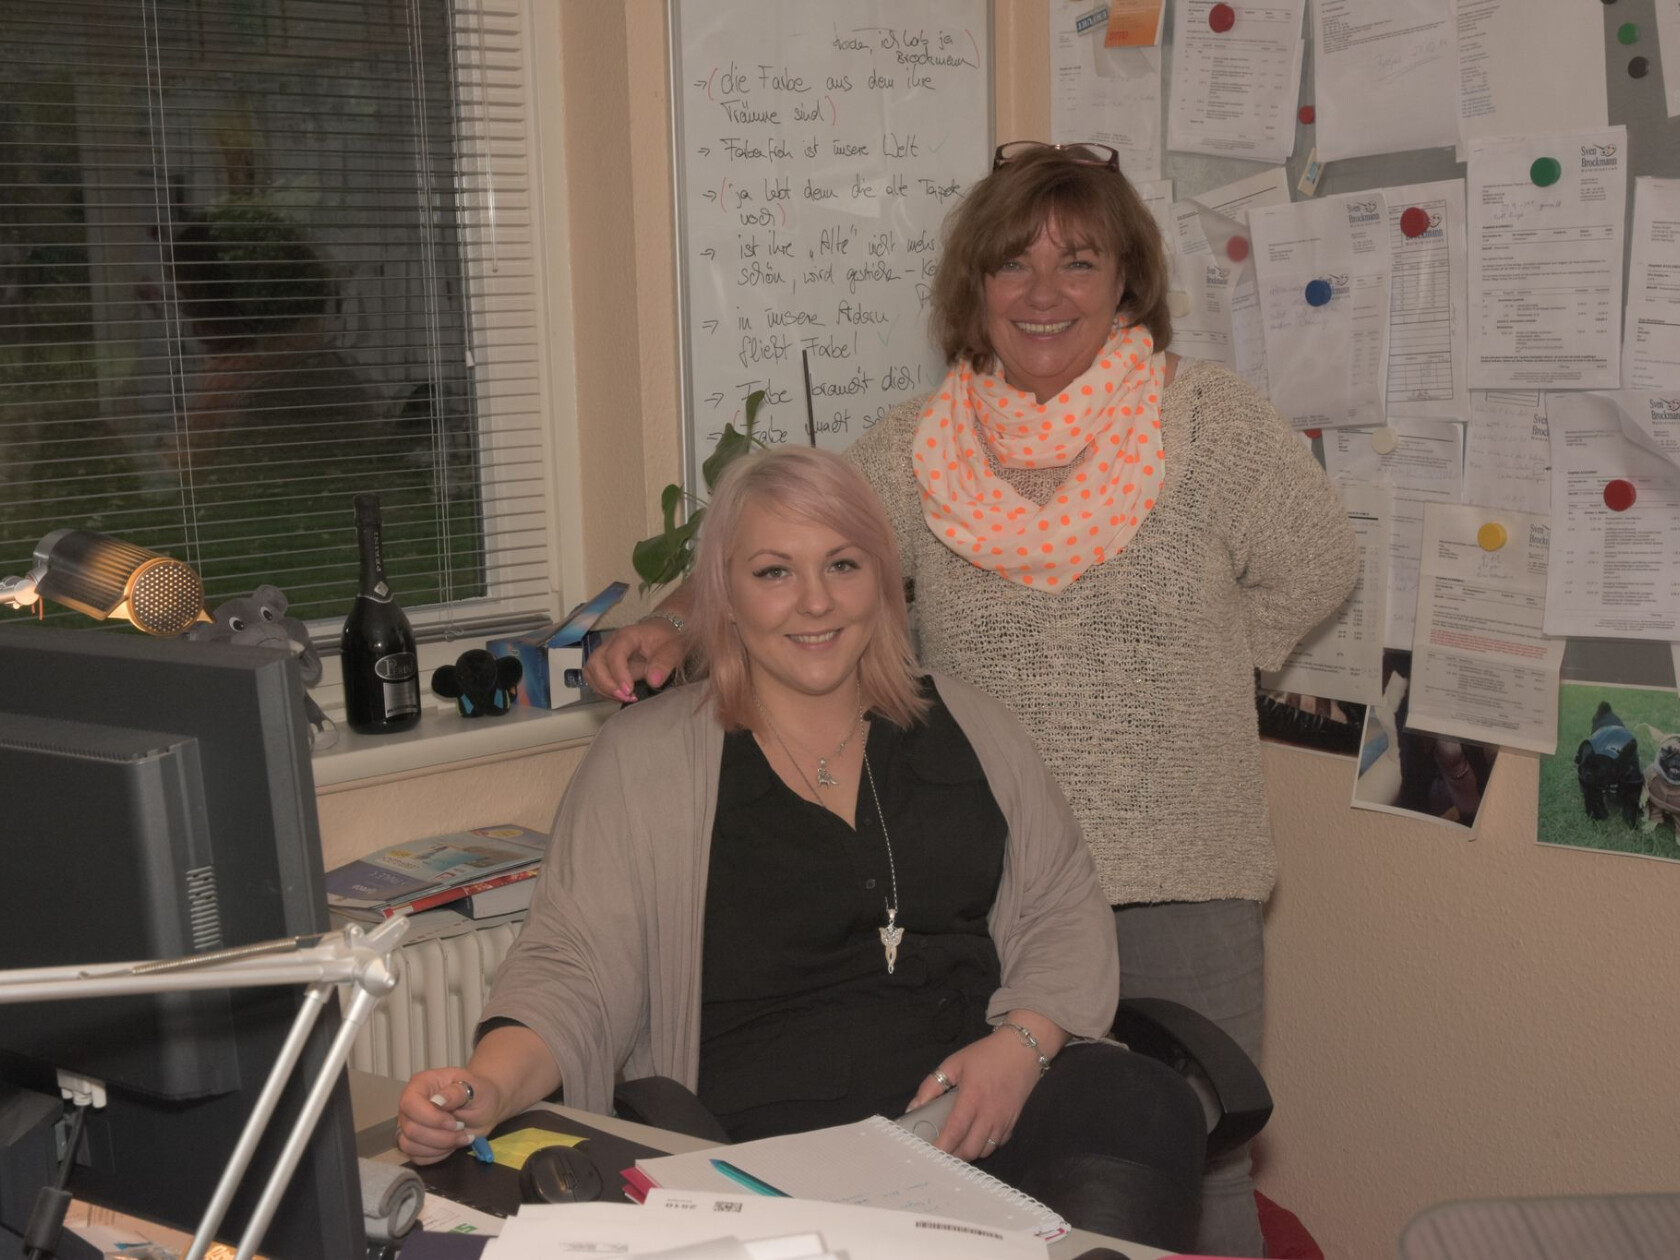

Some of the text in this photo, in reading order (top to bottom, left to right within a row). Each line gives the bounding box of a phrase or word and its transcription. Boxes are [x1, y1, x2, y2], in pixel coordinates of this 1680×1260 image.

[826, 75, 853, 92] aus
[801, 136, 819, 158] ist
[883, 132, 919, 159] Welt
[1581, 146, 1597, 156] Sven
[1581, 157, 1618, 168] Brockmann
[852, 172, 876, 199] die
[737, 234, 760, 260] ist
[803, 264, 835, 285] wird
[737, 306, 752, 330] in
